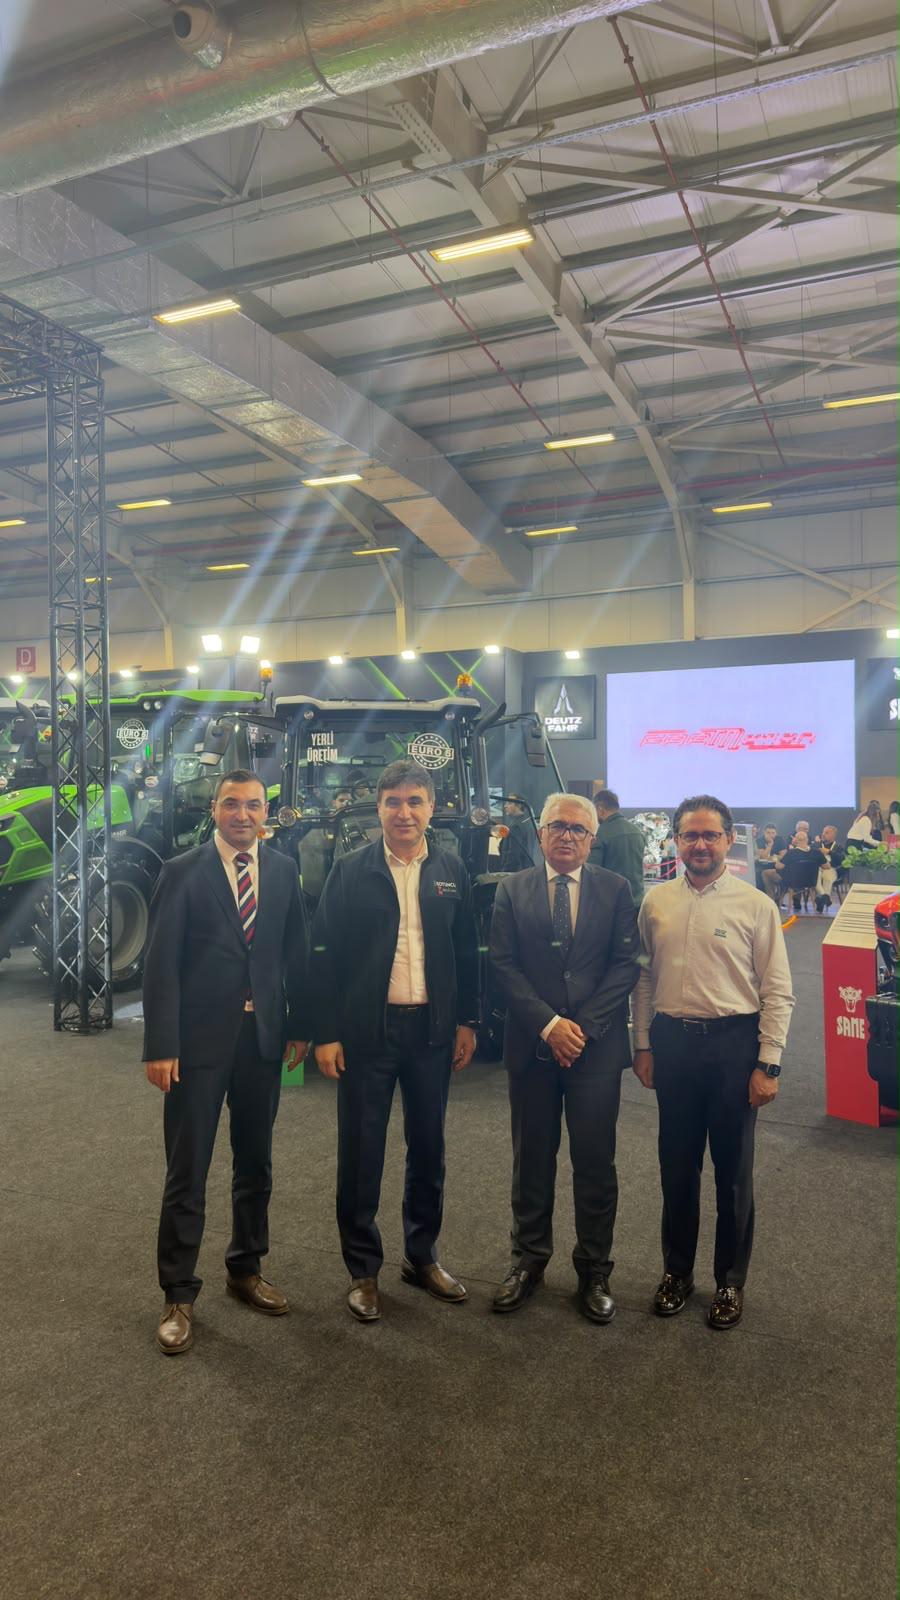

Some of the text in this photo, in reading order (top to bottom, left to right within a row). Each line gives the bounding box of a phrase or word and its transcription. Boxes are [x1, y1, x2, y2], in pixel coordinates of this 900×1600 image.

[20, 648, 31, 665] D
[544, 717, 583, 725] DEUTZ
[119, 730, 140, 738] EURO
[311, 730, 334, 746] YERLİ
[307, 747, 338, 762] ÜRETİM
[411, 745, 442, 757] EURO
[836, 1016, 865, 1040] SAME
